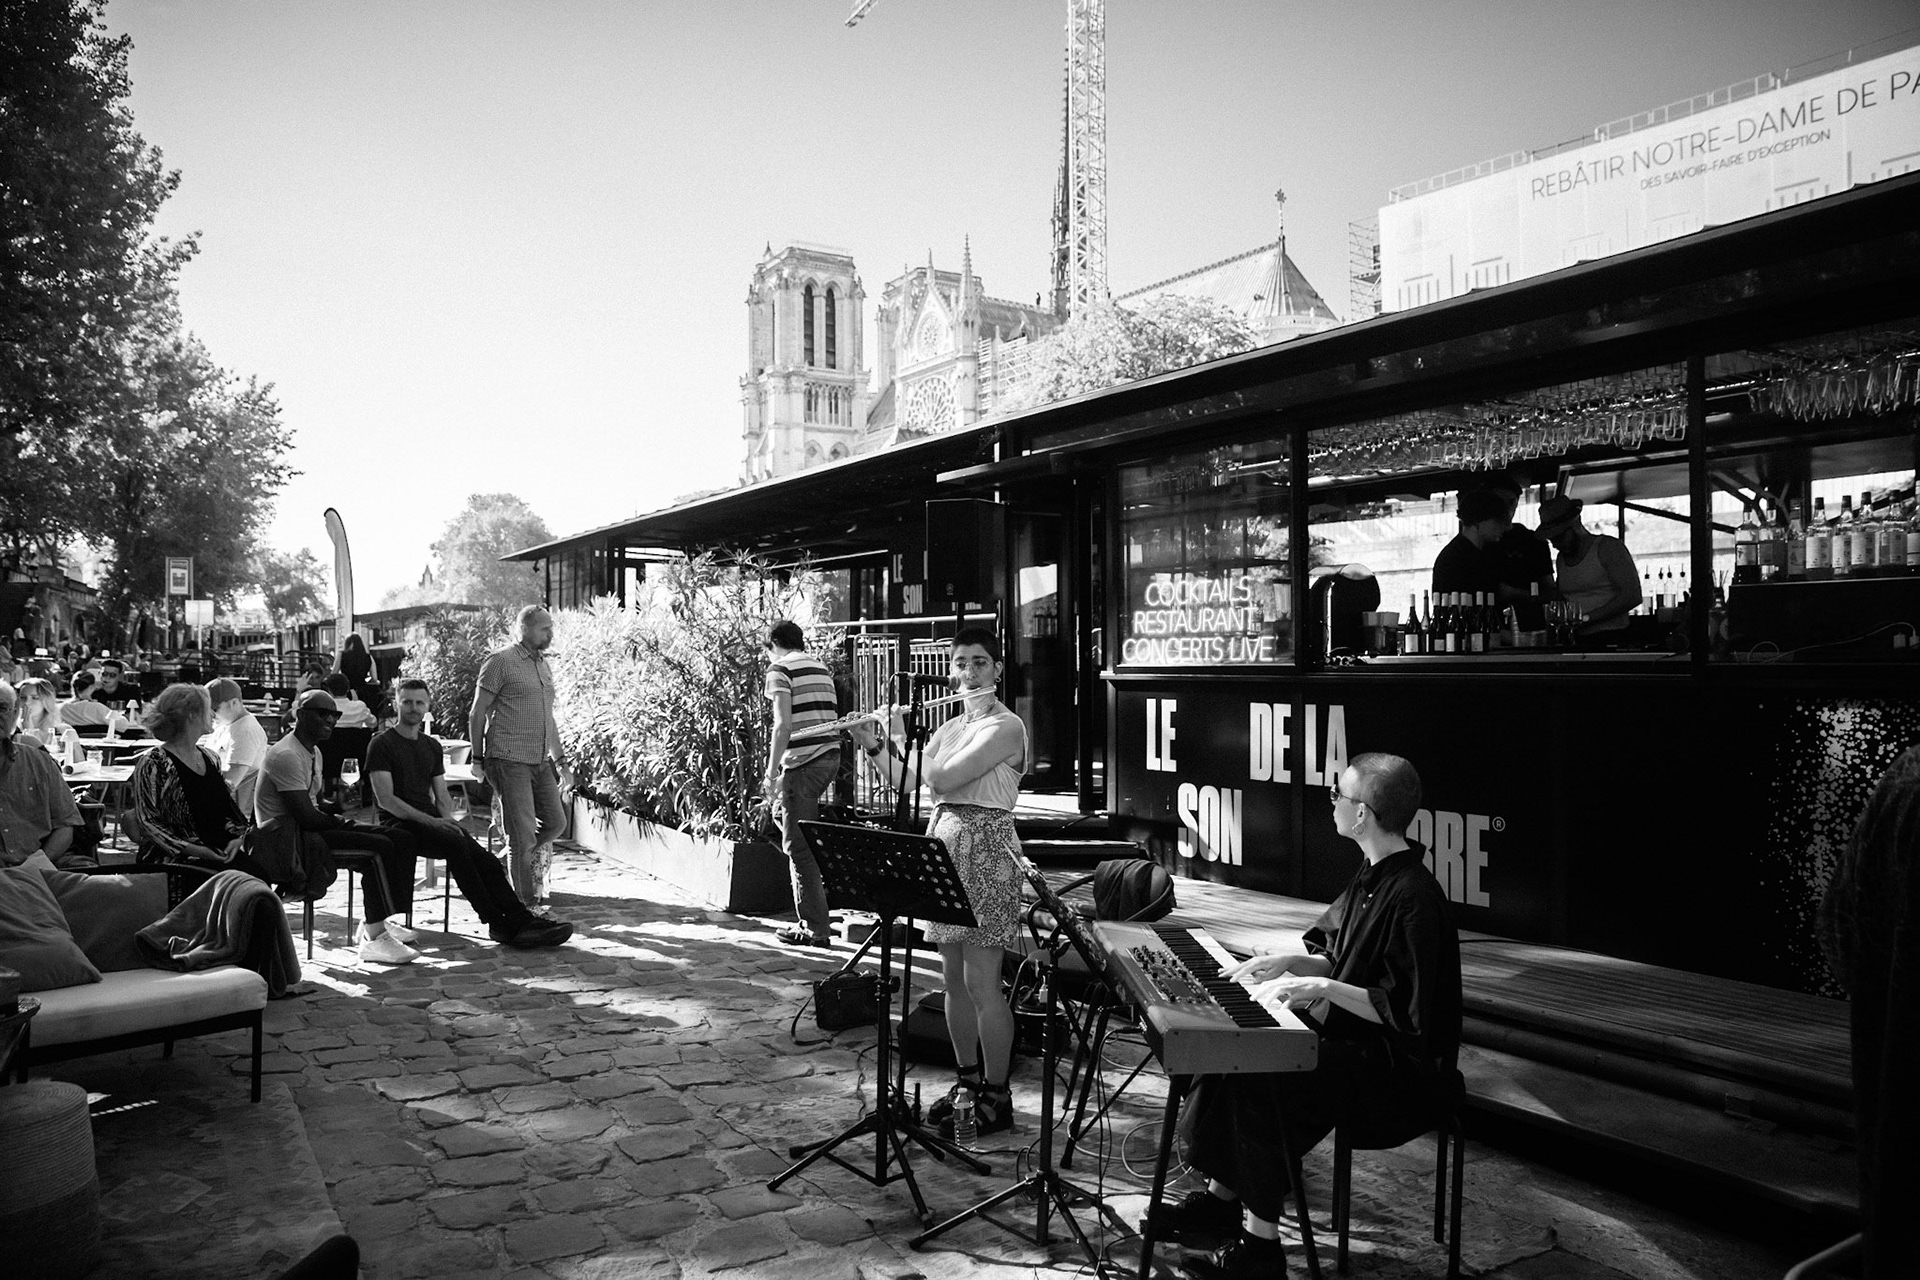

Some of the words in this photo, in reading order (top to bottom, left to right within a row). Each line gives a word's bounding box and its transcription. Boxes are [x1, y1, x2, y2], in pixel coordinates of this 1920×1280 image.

[1531, 155, 1625, 201] REBÂTIR
[1632, 95, 1825, 173] NOTRE-DAME
[1837, 79, 1877, 116] DE
[1640, 175, 1662, 191] DES
[1664, 152, 1744, 184] SAVOIR-FAIRE
[1748, 128, 1831, 162] D'EXCEPTION
[893, 553, 903, 583] LE
[903, 584, 923, 615] SON
[1145, 576, 1252, 607] COCKTAILS
[1133, 606, 1257, 634] RESTAURANT
[1122, 636, 1225, 662] CONCERTS
[1229, 635, 1275, 662] LIVE
[1146, 698, 1177, 772] LE
[1249, 702, 1292, 784] DE
[1304, 704, 1348, 787] LA
[1177, 782, 1243, 866] SON
